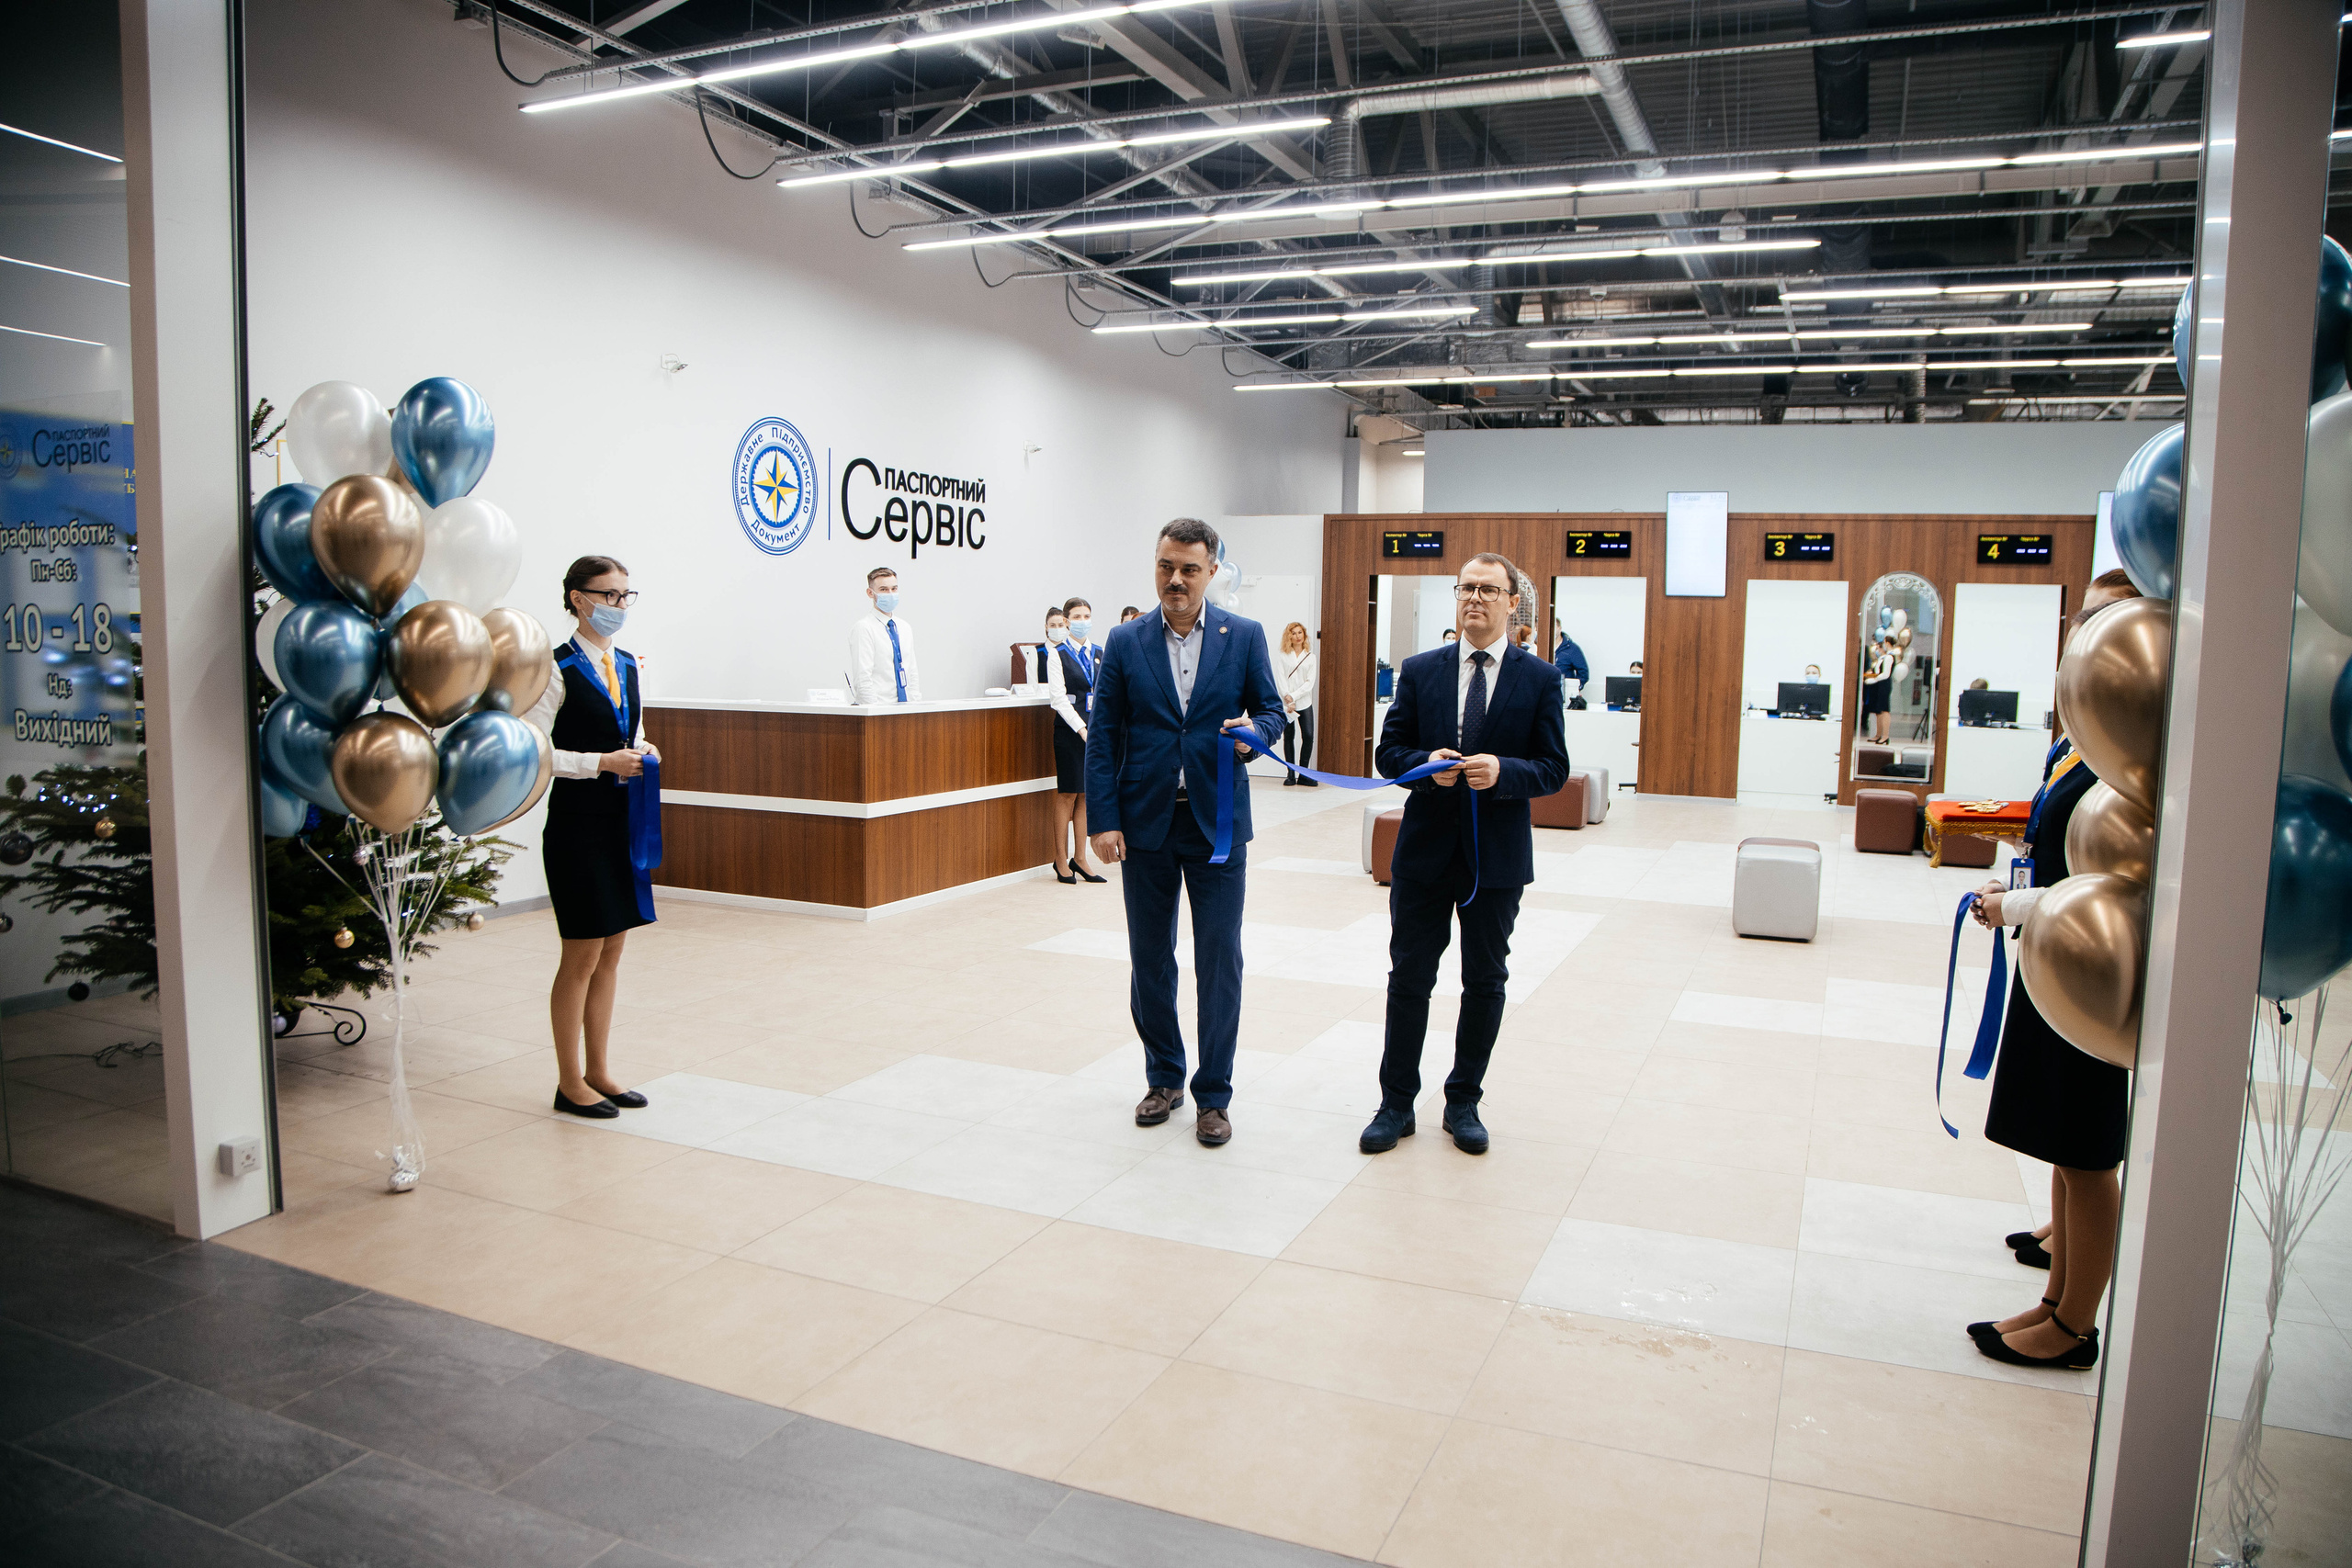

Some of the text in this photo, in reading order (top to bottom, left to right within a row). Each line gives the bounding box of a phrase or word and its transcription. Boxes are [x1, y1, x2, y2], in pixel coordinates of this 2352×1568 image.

[51, 423, 110, 442] ПАСПОРТНИЙ
[32, 429, 111, 473] Сервіс
[739, 426, 812, 515] Державне Підприємство
[884, 467, 987, 503] ПАСПОРТНИЙ
[841, 457, 987, 559] Сервіс
[0, 518, 115, 554] рафік роботи:
[751, 518, 801, 545] Документ
[1392, 539, 1399, 554] 1
[1576, 538, 1586, 554] 2
[1773, 540, 1786, 557] 3
[1986, 543, 2000, 559] 4
[30, 558, 78, 582] Пн-Сб:
[3, 603, 44, 653] 10
[70, 603, 114, 654] 18
[48, 672, 73, 699] Нд:
[14, 707, 112, 748] Вихідний
